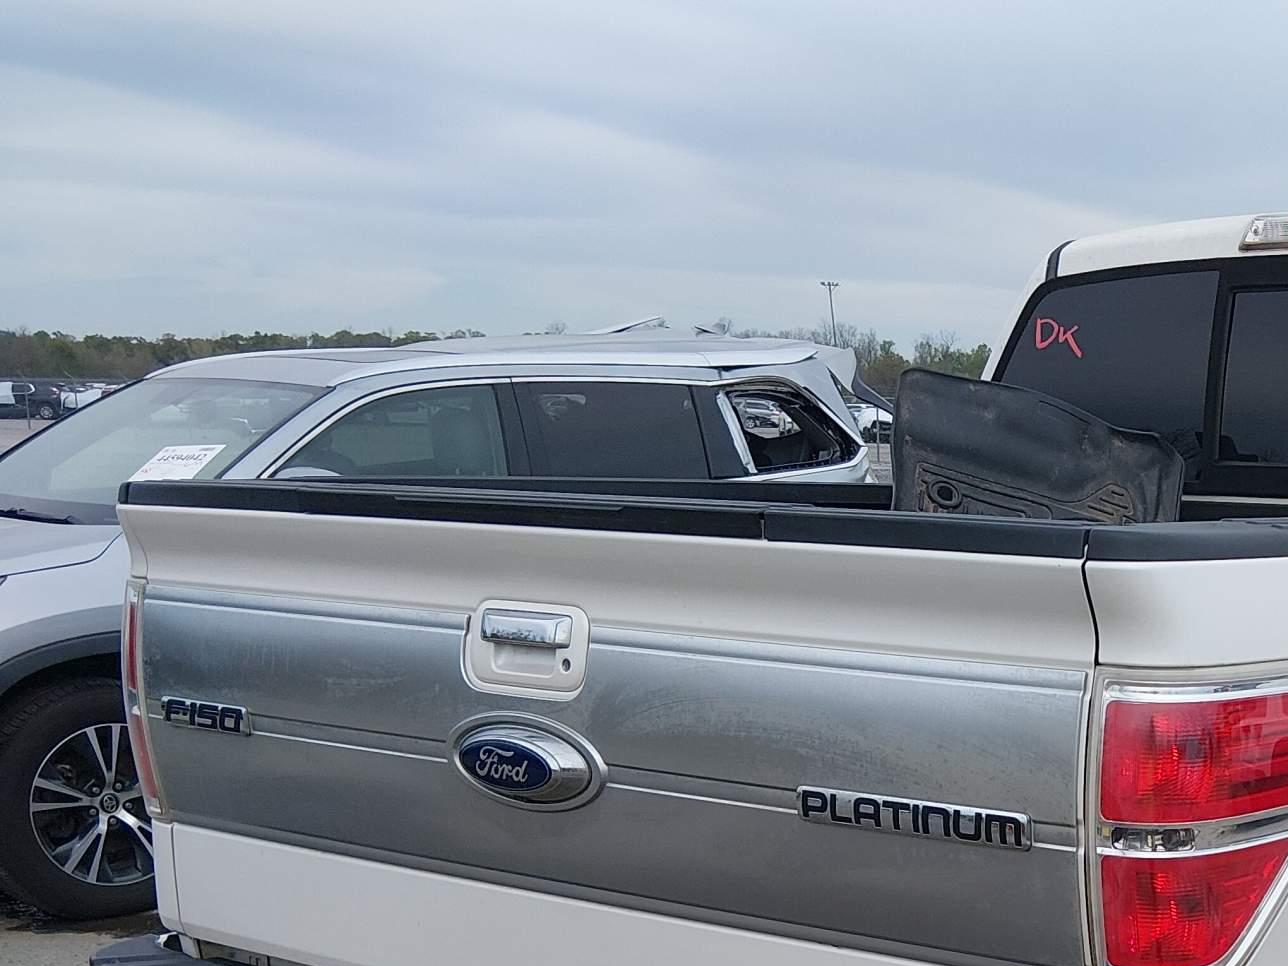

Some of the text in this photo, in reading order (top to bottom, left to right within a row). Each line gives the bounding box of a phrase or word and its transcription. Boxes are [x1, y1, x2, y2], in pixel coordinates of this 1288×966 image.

[1035, 317, 1083, 359] DK
[475, 745, 528, 783] Ford
[801, 790, 1024, 849] PLATINUM
